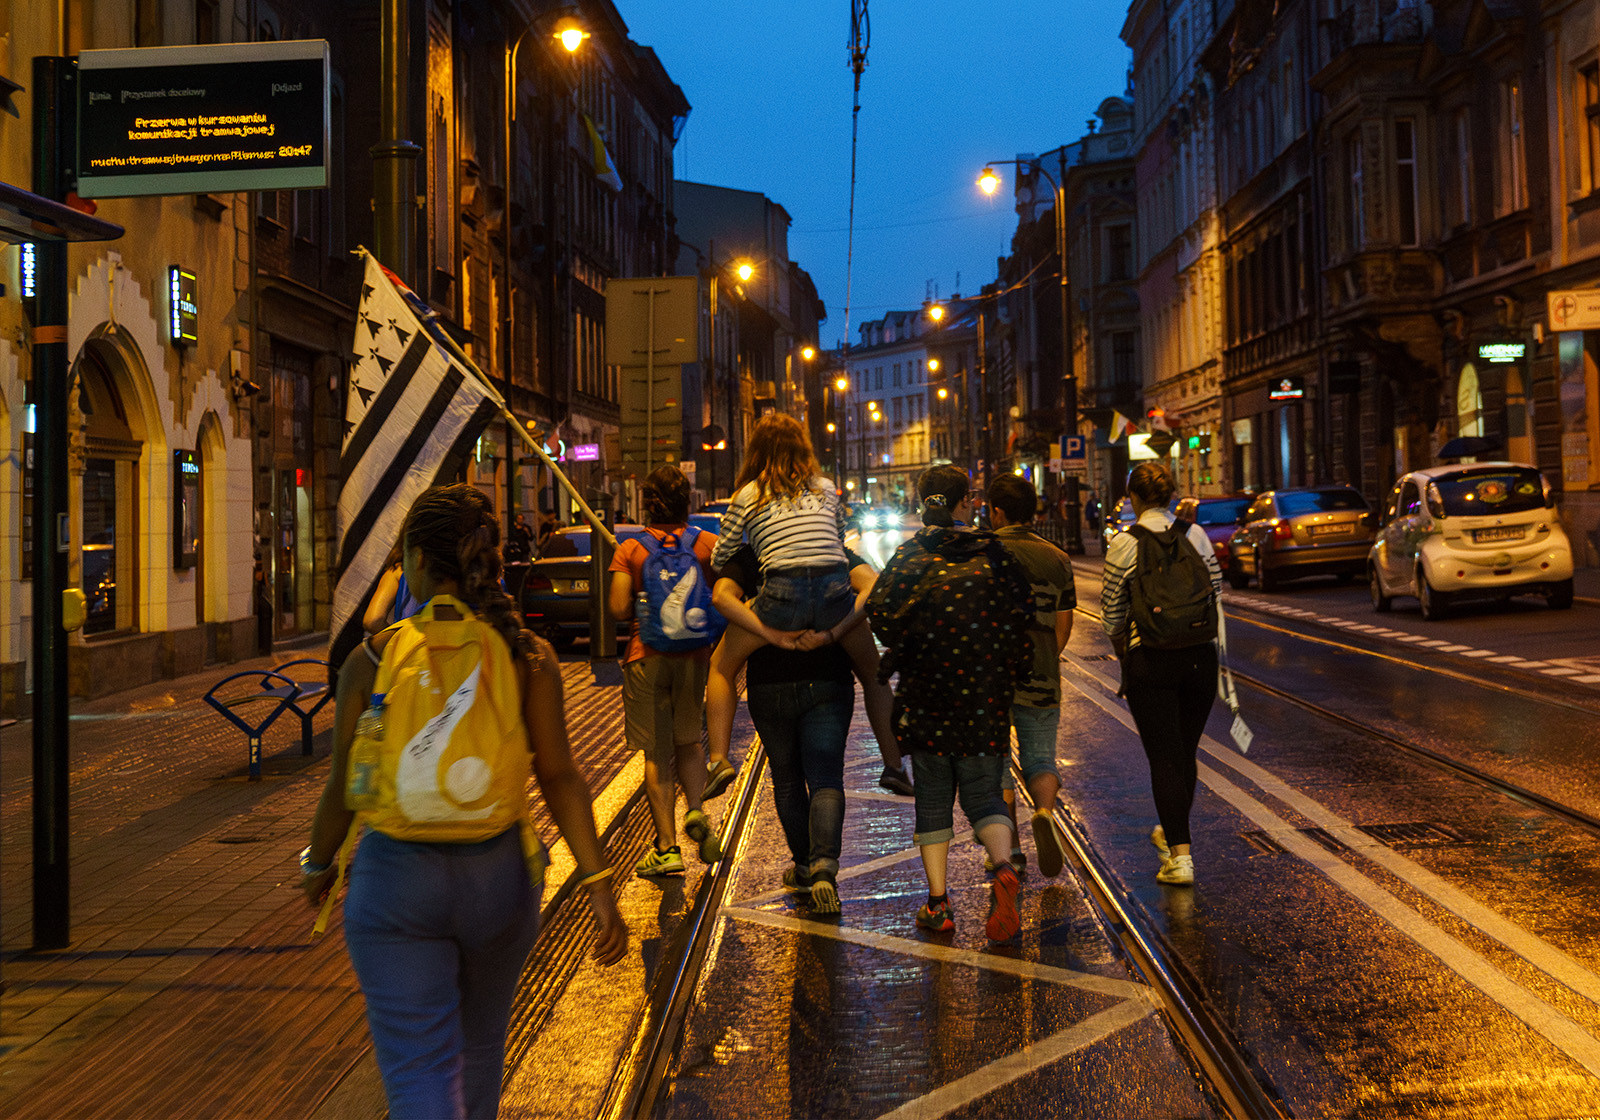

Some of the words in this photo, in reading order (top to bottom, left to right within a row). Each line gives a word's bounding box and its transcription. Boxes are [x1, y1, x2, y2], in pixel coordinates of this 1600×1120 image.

[123, 90, 167, 100] Przystanek
[168, 88, 206, 98] docelowy
[274, 82, 303, 93] Odjazd
[135, 117, 187, 128] Przerwa
[187, 117, 197, 126] w
[198, 112, 267, 126] kursowaniu
[128, 127, 198, 140] komunikacji
[200, 123, 275, 137] tramwajowej
[278, 144, 313, 157] 20:47
[1066, 437, 1081, 456] P
[250, 738, 259, 764] MPK
